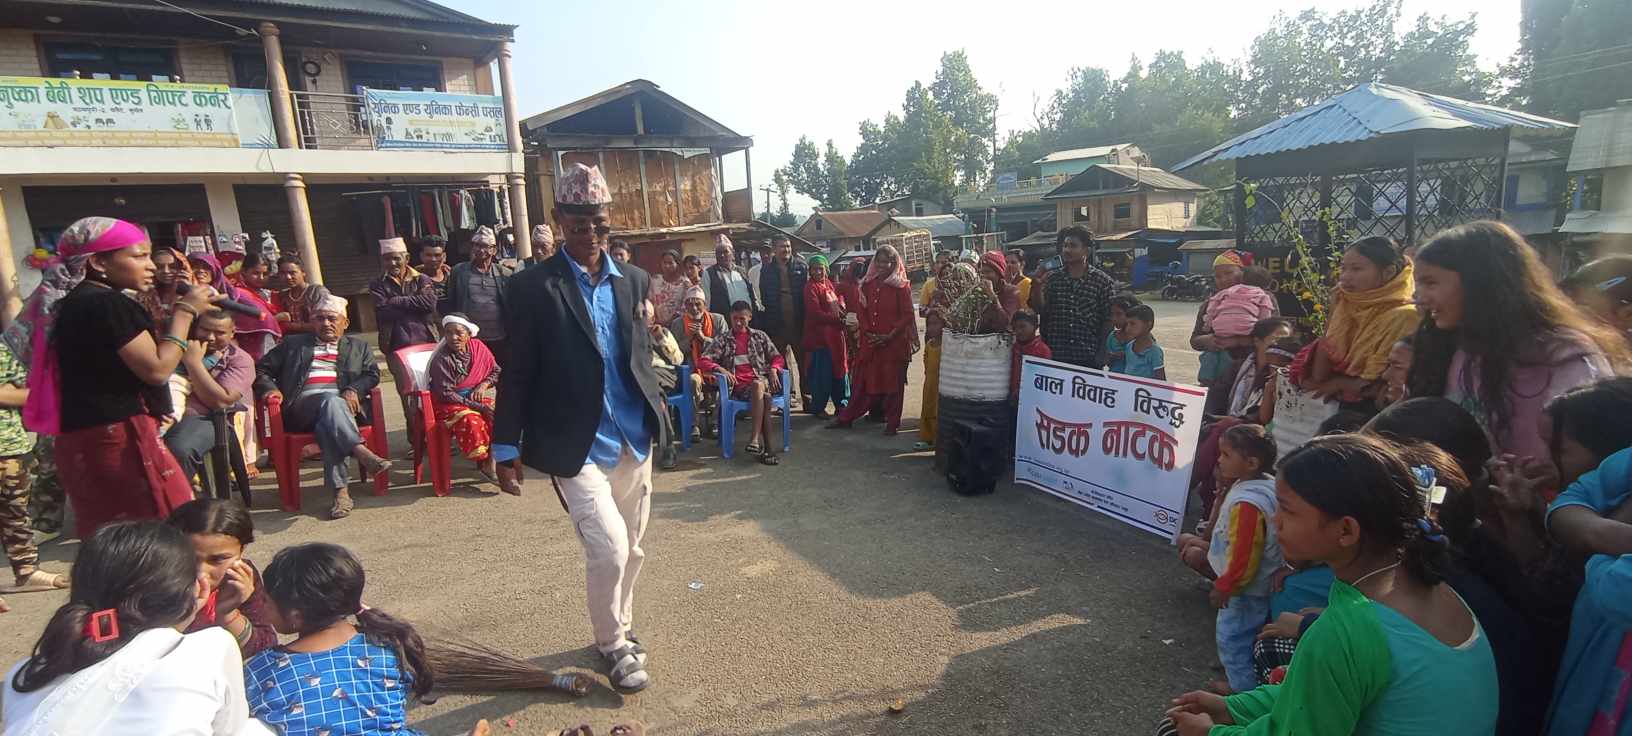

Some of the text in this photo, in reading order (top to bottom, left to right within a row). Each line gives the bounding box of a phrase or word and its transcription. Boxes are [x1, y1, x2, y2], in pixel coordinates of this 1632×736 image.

[44, 80, 73, 104] बेबी
[77, 87, 105, 106] शप
[109, 88, 142, 105] एण्ड
[146, 83, 188, 107] गिफ्ट
[191, 87, 231, 110] कर्नर
[402, 103, 420, 115] एण्ड
[481, 106, 503, 119] पसल
[1034, 373, 1064, 396] बाल
[1071, 375, 1118, 409] विवाह
[1035, 406, 1093, 459] सडक
[1101, 420, 1179, 472] नाटक
